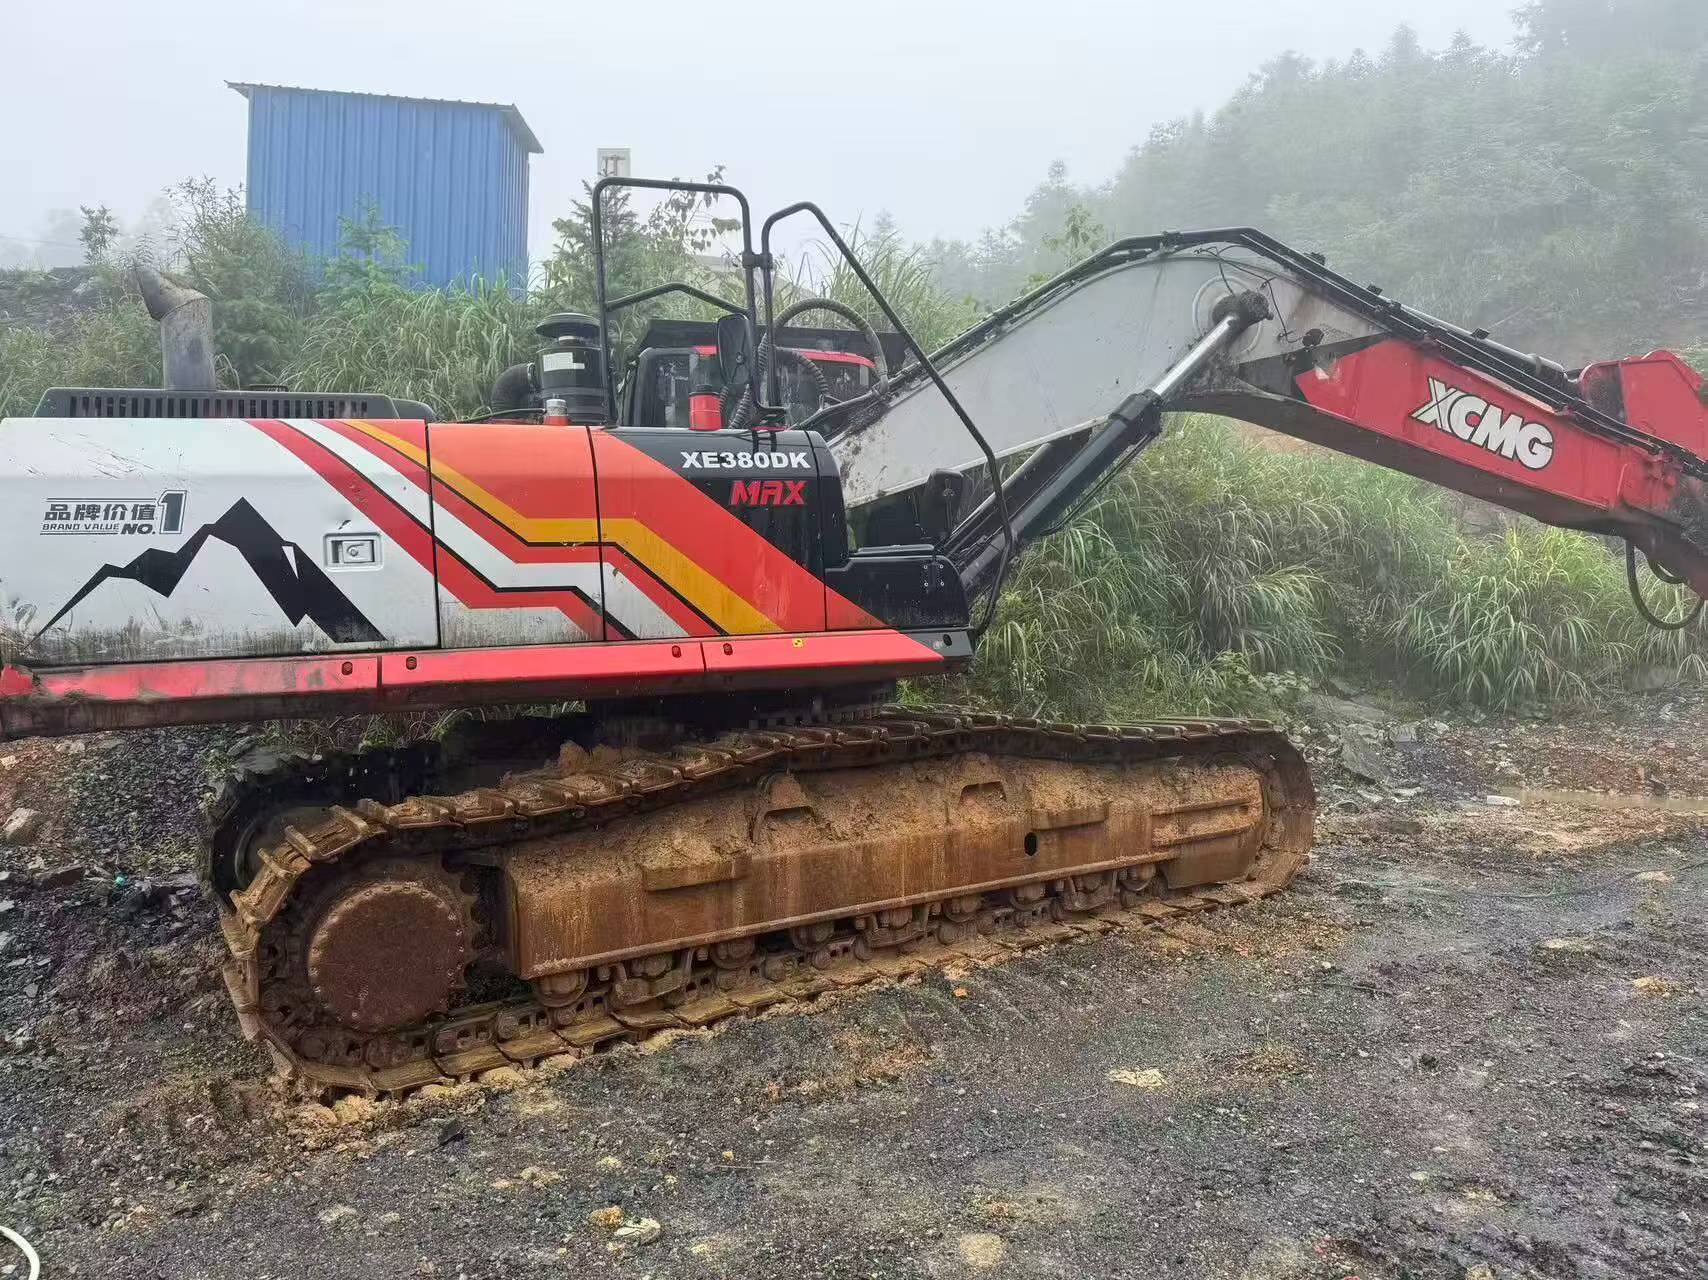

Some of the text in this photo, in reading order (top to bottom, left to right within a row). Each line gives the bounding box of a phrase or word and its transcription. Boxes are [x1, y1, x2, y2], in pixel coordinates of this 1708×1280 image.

[1409, 376, 1554, 470] XCMG
[681, 451, 811, 469] XE380DK
[730, 480, 807, 505] MAX
[44, 503, 156, 521] 品牌价值
